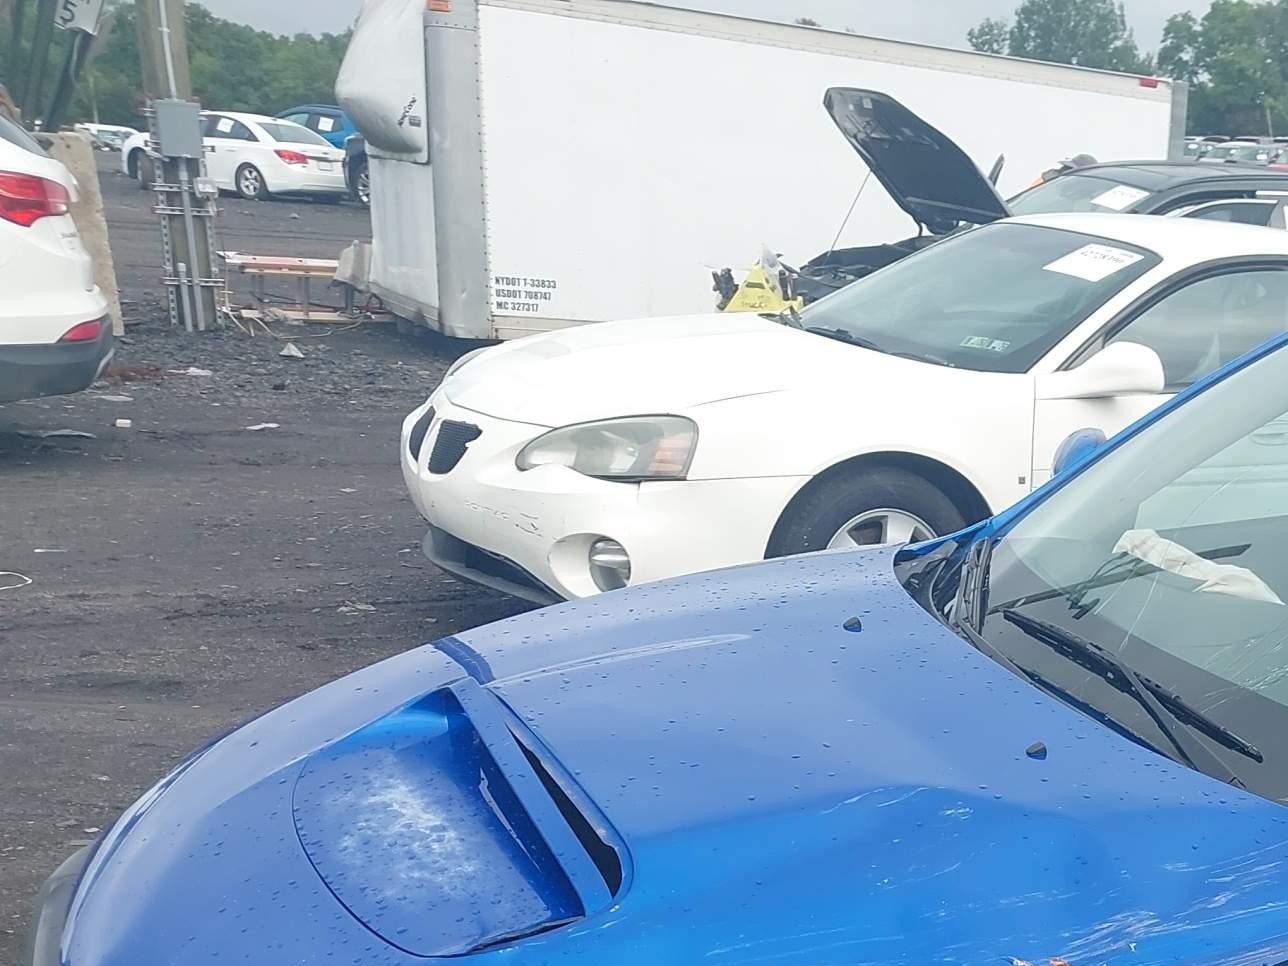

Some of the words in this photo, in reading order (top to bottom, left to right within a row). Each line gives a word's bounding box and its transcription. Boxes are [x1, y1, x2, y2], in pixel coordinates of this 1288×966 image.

[495, 276, 521, 287] NYDOT
[495, 289, 522, 300] USDOT
[496, 301, 510, 311] MC
[510, 302, 539, 312] 327317
